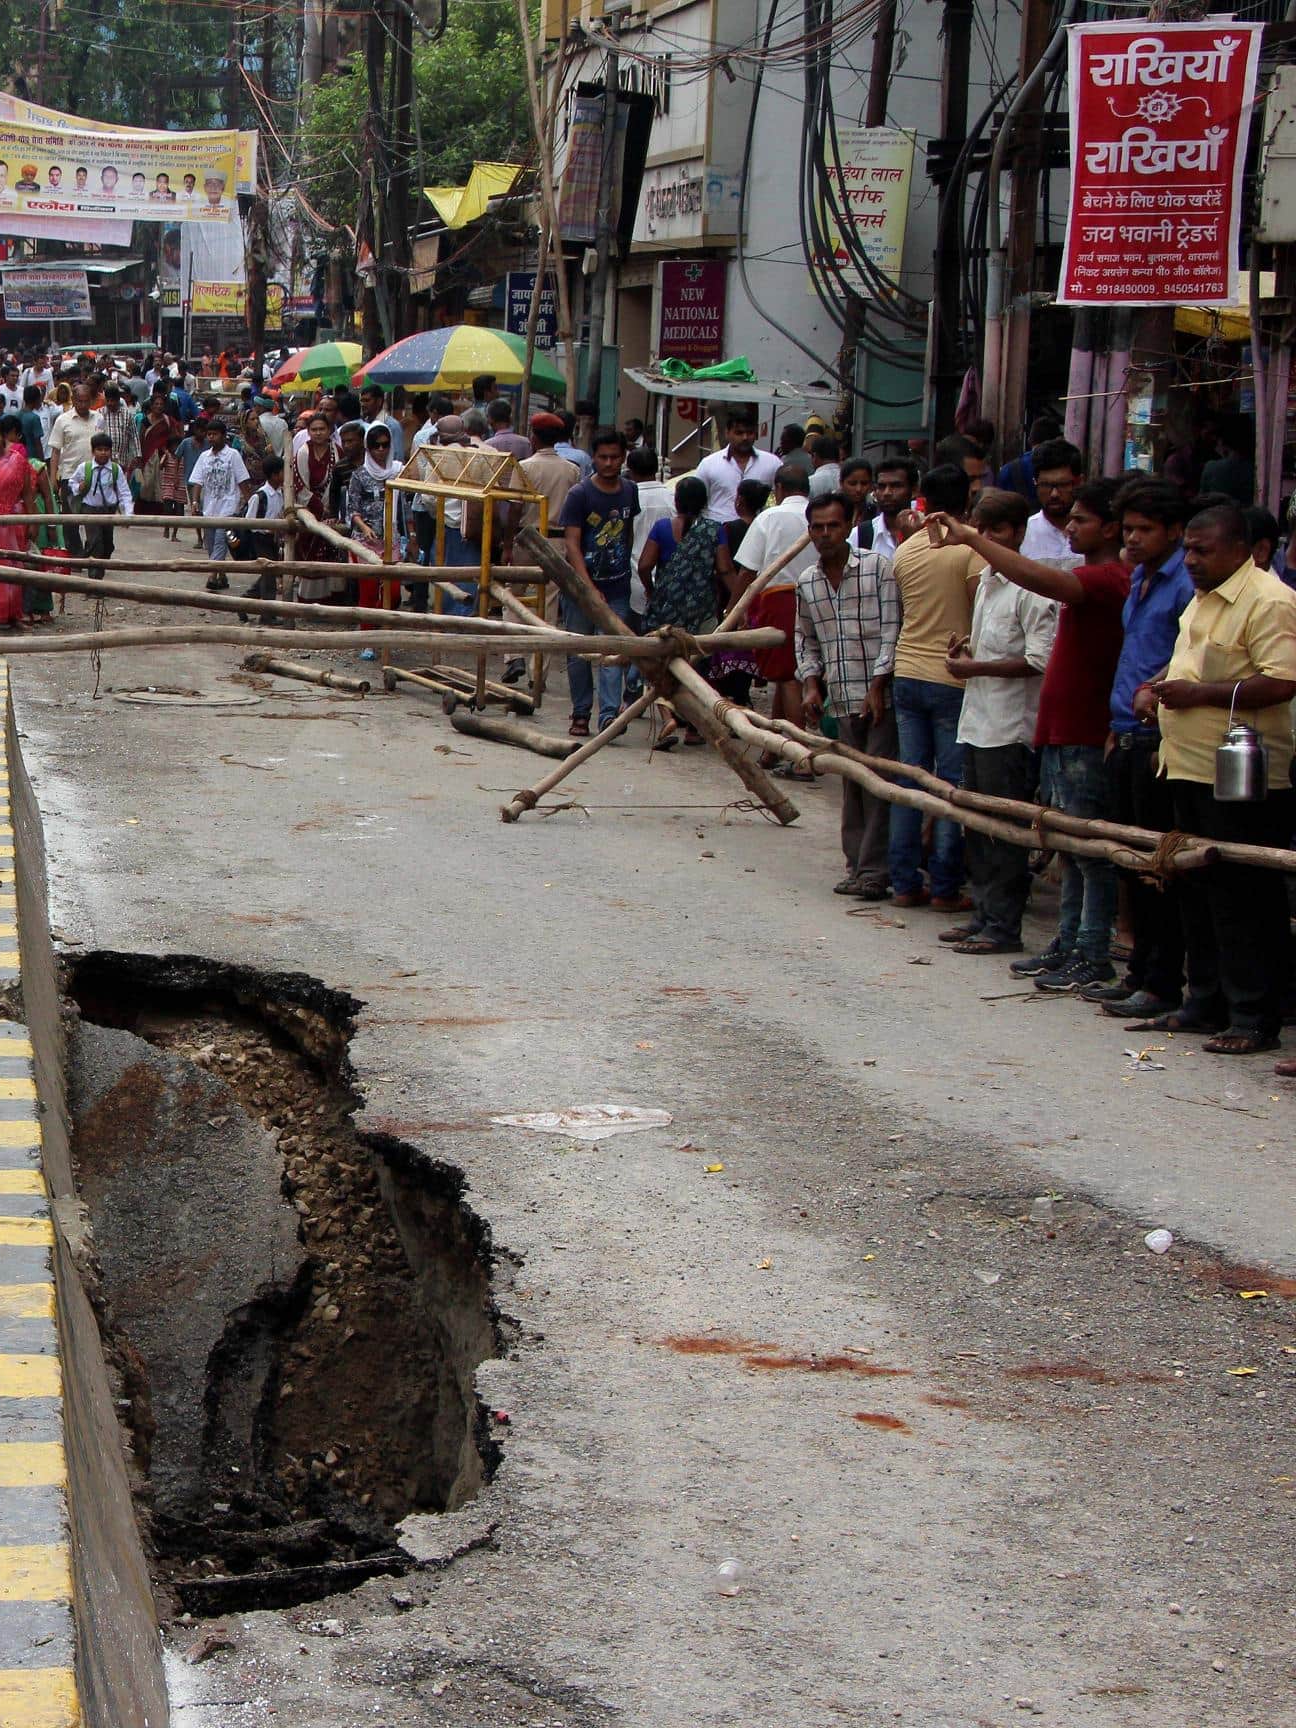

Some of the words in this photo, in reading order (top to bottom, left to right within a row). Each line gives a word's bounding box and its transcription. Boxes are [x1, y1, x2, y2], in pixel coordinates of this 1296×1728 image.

[1089, 35, 1242, 87] राखियाँ
[1085, 125, 1229, 175] राखियाँ
[825, 161, 867, 182] कहैया
[871, 167, 904, 183] लाल
[1082, 190, 1113, 209] बेचने
[1115, 191, 1128, 208] के
[1130, 190, 1155, 208] लिए
[1157, 190, 1185, 208] थोक
[1082, 225, 1115, 243] जय
[1118, 218, 1173, 243] भवानी
[1175, 217, 1220, 249] ट्रेडर्स
[1096, 253, 1120, 262] समाज
[680, 287, 705, 301] NEW
[664, 306, 720, 321] NATIONAL
[663, 325, 718, 341] MEDICALS
